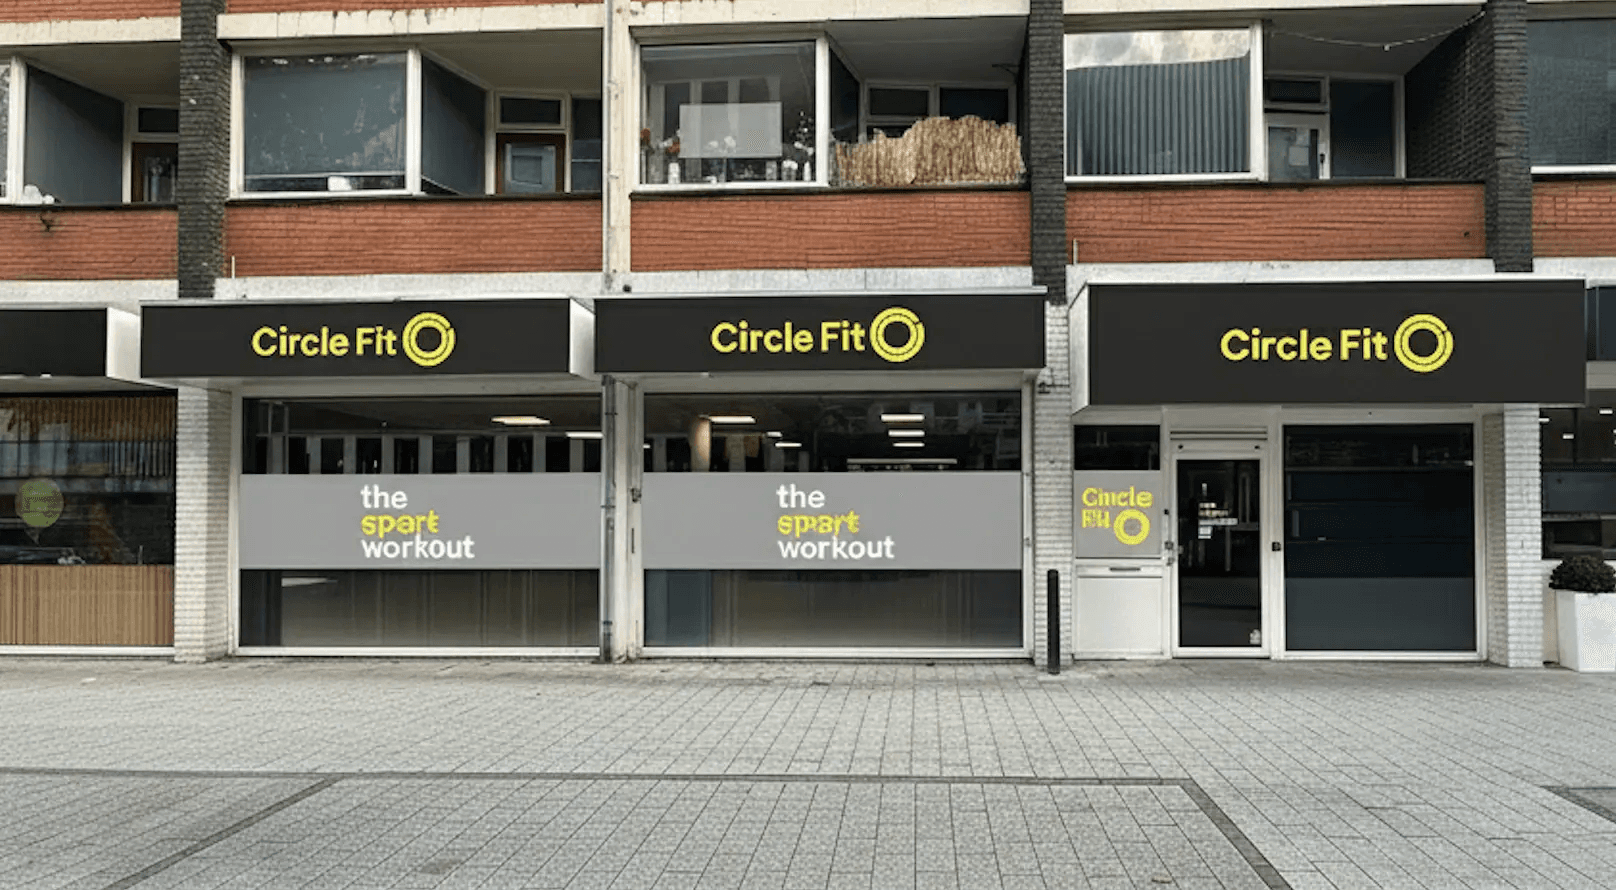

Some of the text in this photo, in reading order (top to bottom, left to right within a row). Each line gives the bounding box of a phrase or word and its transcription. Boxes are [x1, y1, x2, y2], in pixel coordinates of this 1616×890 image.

[251, 326, 397, 357] Circle Fit
[711, 320, 866, 353] Circle Fit
[1220, 327, 1388, 361] Circle Fit
[360, 484, 408, 509] the
[776, 483, 825, 509] the
[360, 533, 475, 559] workout
[777, 535, 895, 559] workout
